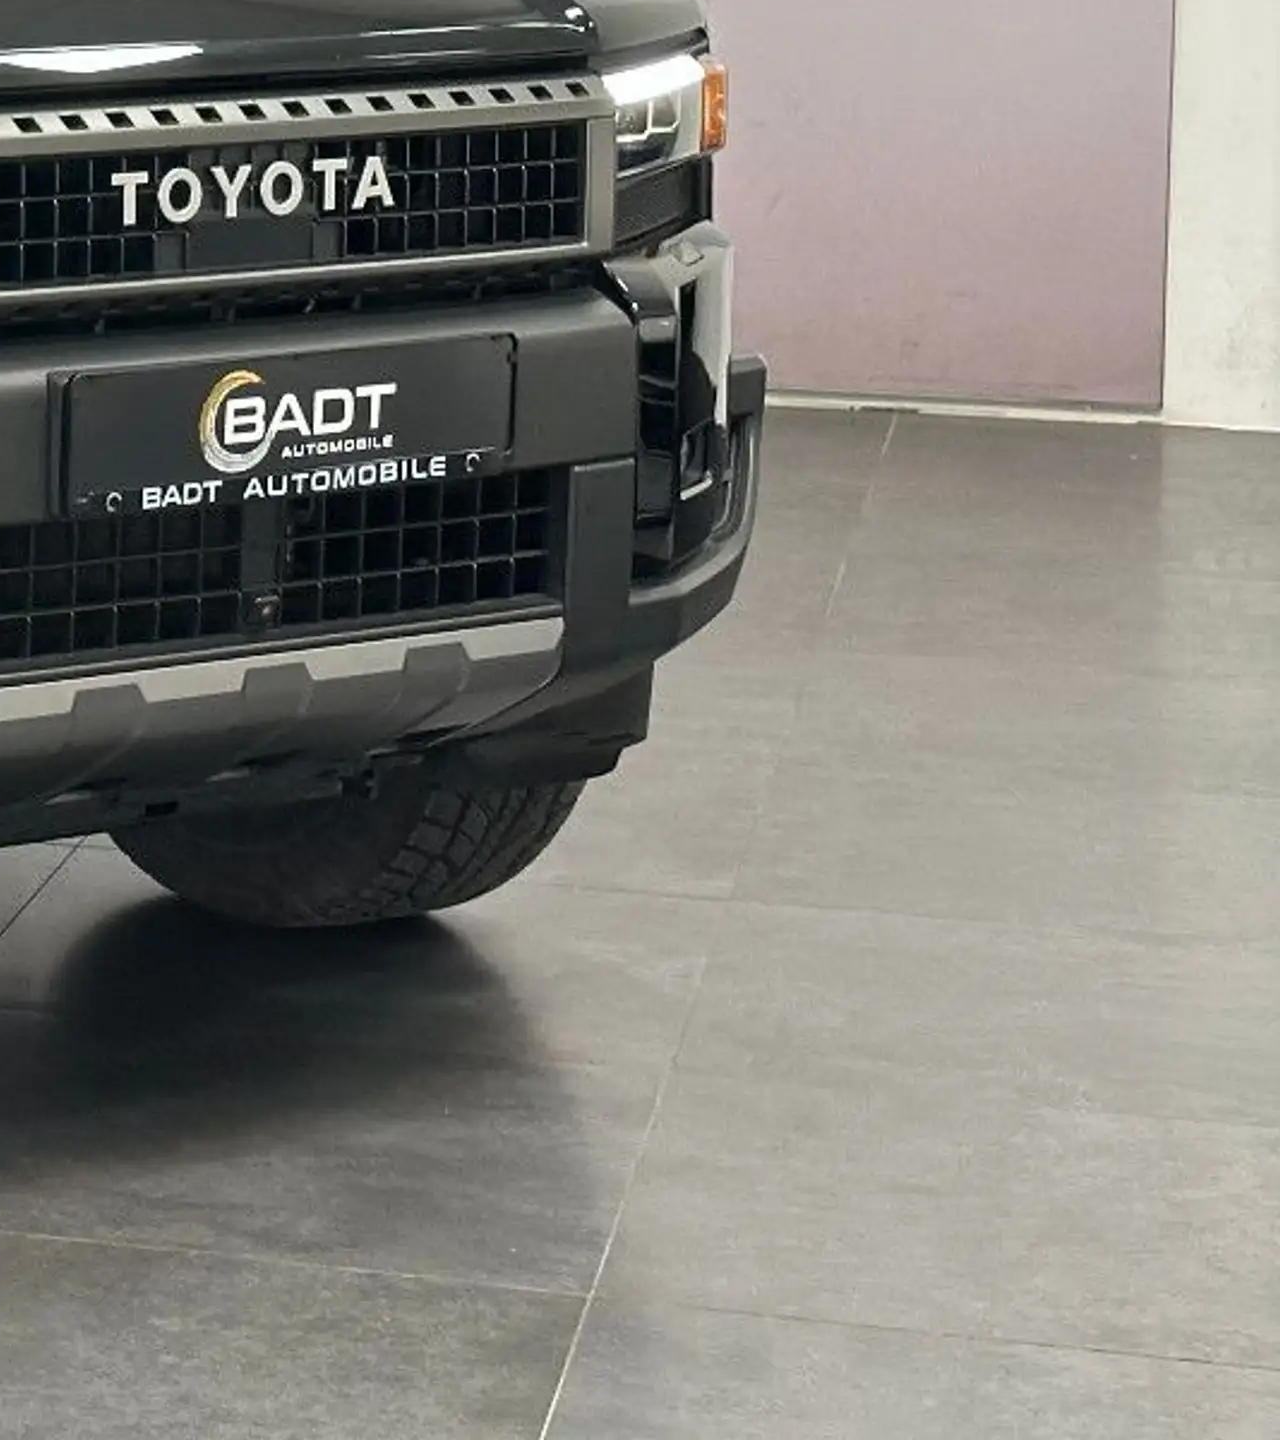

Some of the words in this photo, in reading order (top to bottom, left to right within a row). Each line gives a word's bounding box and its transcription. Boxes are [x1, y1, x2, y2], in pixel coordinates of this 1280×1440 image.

[111, 154, 396, 227] TOYOTA
[223, 382, 397, 445] BADT
[281, 434, 394, 459] AUTOMOBILE
[142, 479, 223, 510] BADT
[243, 455, 447, 500] AUTOMOBILE
